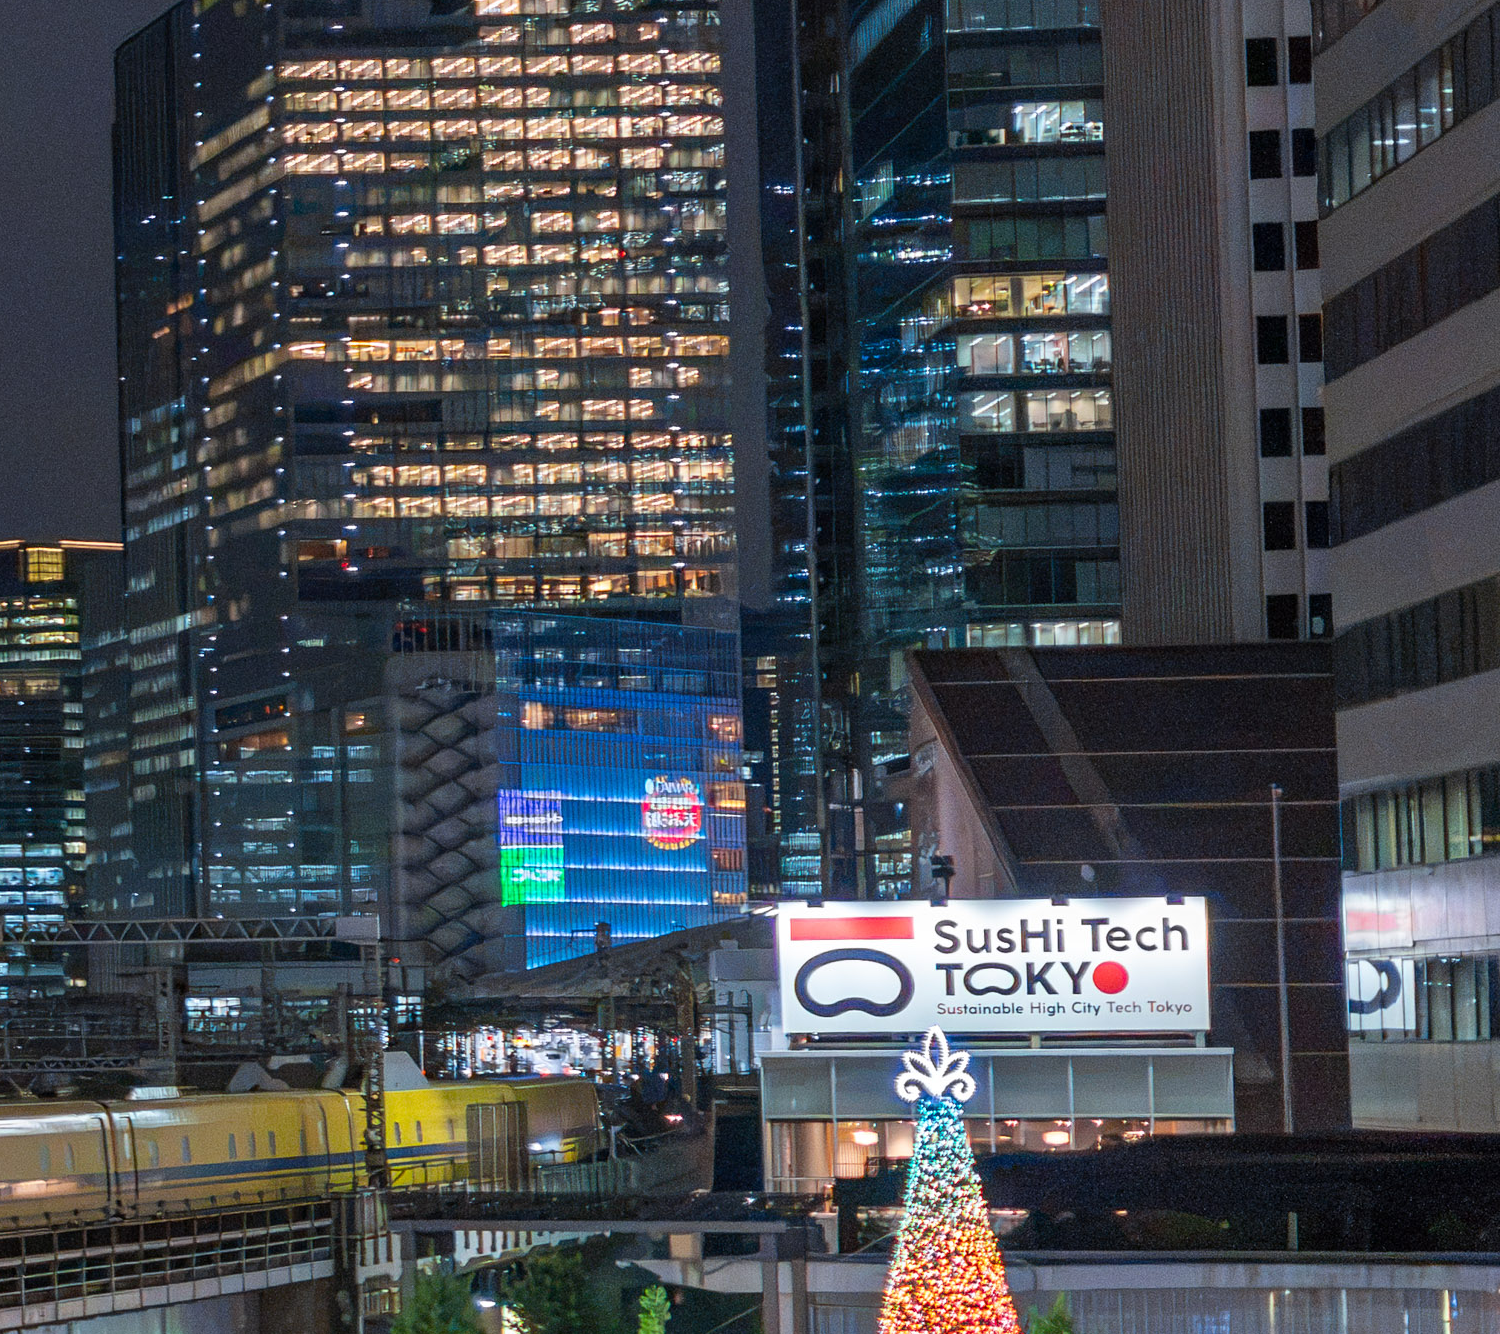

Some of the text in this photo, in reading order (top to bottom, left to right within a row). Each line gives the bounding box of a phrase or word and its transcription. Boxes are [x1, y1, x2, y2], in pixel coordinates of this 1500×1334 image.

[933, 916, 1190, 955] SusHi Tech
[936, 1000, 1193, 1018] Sustainable High City Tech Tokyo
